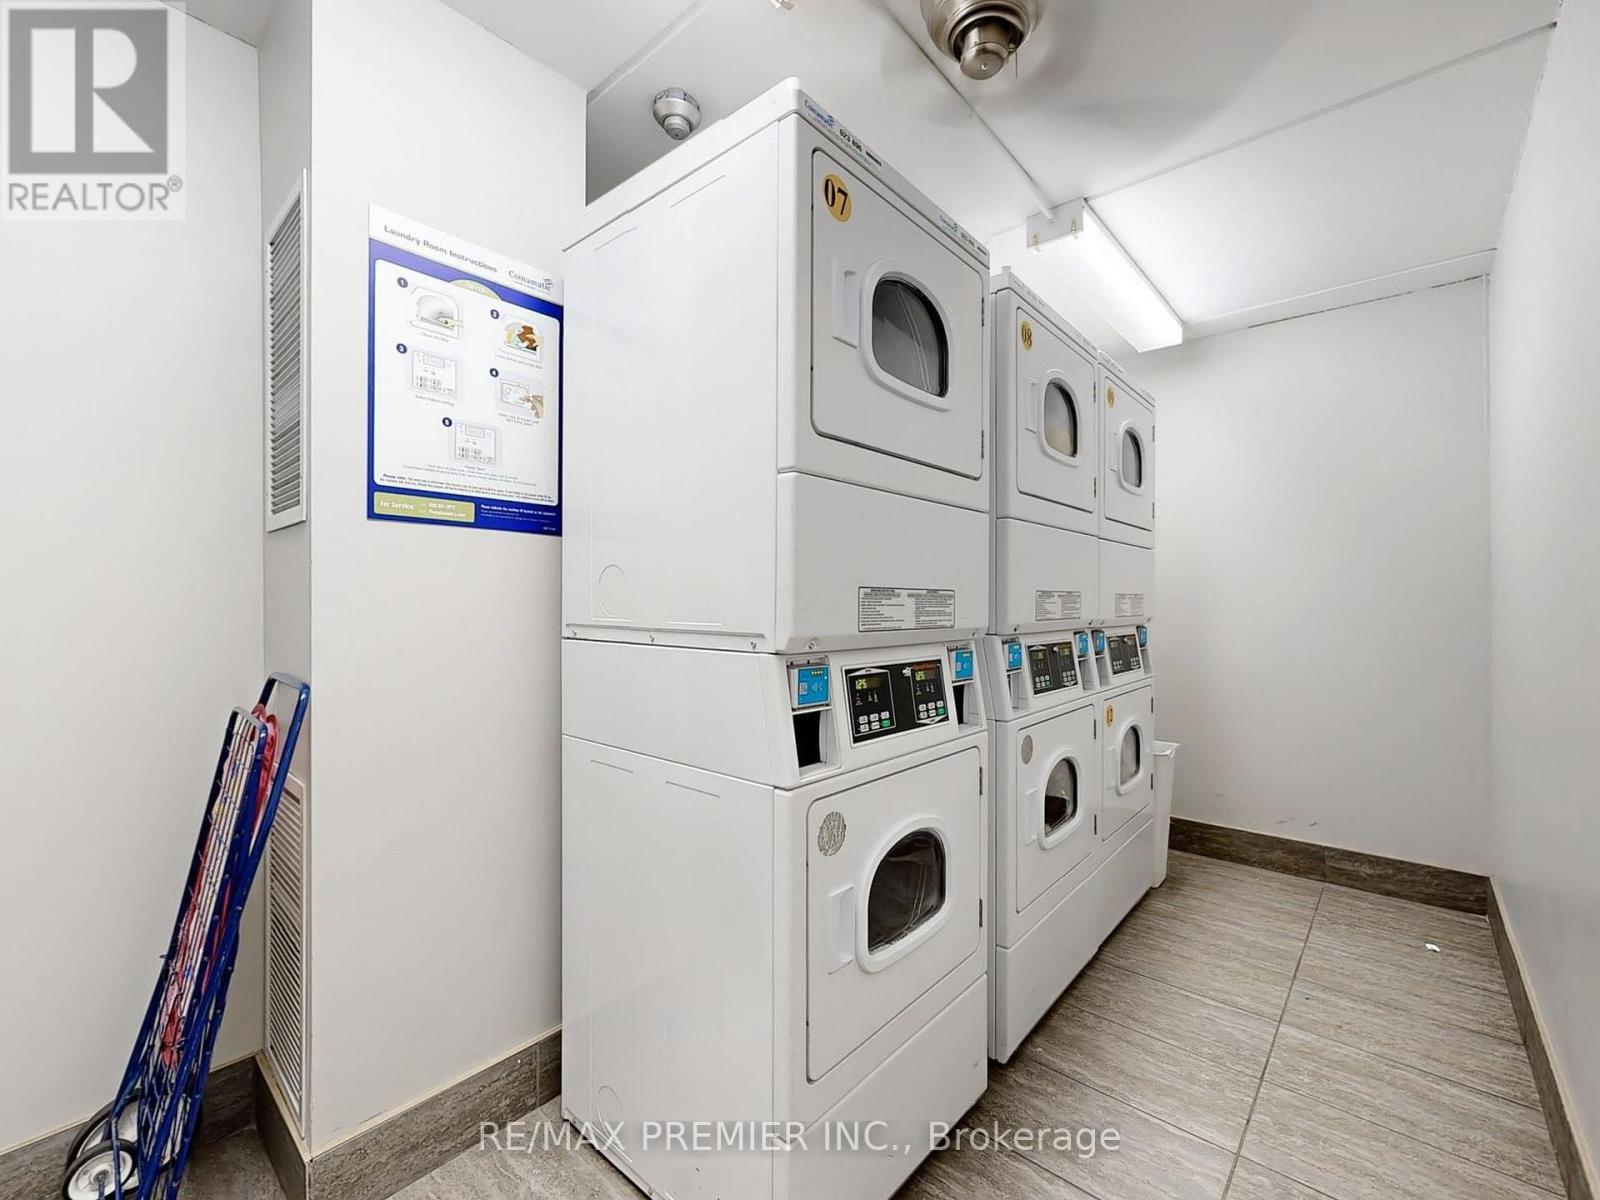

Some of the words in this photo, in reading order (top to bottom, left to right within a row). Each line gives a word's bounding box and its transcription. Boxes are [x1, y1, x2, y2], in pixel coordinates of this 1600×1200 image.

[824, 178, 848, 216] 07
[384, 225, 421, 246] Laundry
[423, 240, 447, 255] Room
[449, 250, 498, 273] Instructions
[508, 270, 553, 292] Coinamatic
[1021, 323, 1033, 348] 08
